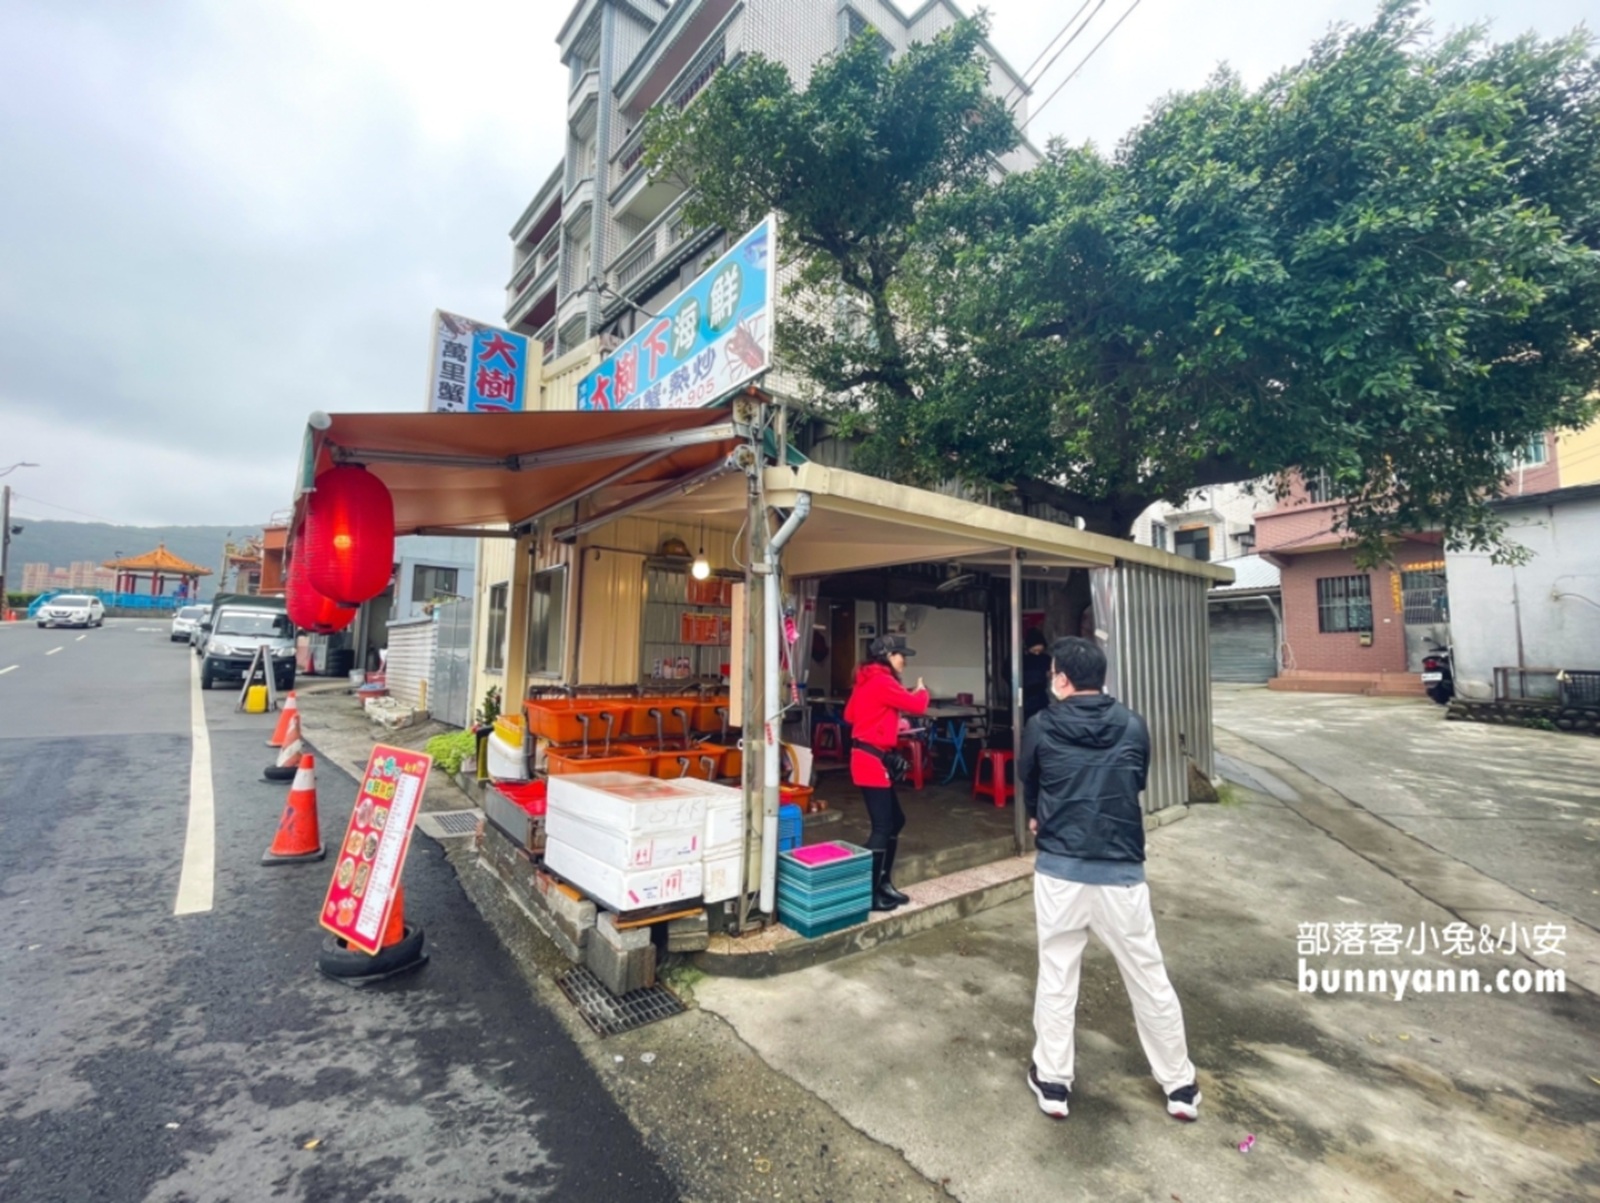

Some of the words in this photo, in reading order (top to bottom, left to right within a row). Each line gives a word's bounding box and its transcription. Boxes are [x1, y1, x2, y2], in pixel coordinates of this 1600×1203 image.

[590, 264, 738, 410] 大樹下海鮮
